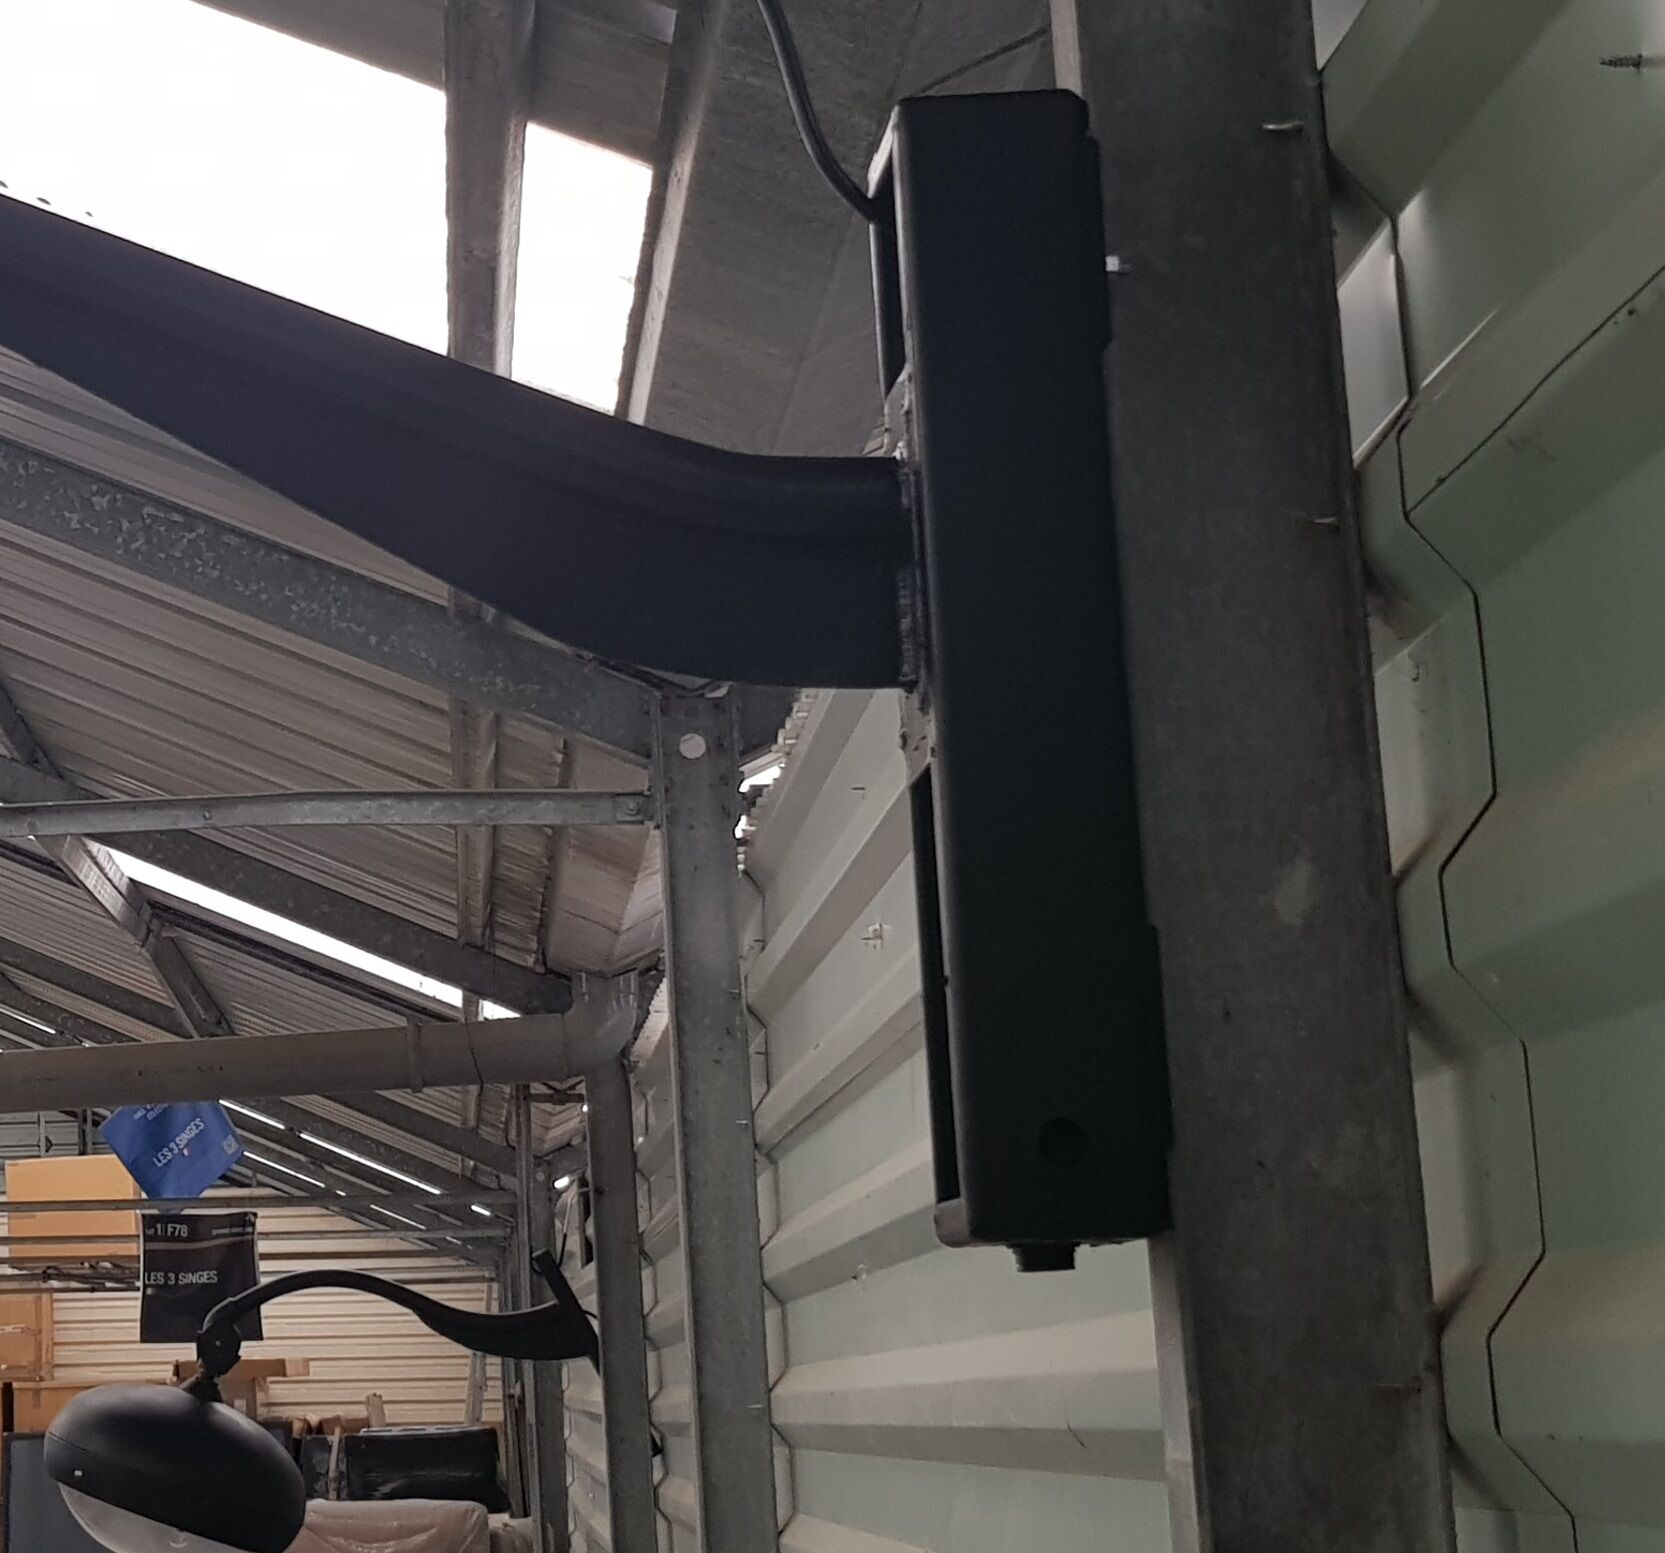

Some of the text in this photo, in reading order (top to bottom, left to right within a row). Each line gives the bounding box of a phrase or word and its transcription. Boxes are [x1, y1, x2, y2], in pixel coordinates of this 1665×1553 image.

[152, 1118, 205, 1168] LES 3 SINGES
[144, 1270, 218, 1285] LES 3 SINGES
